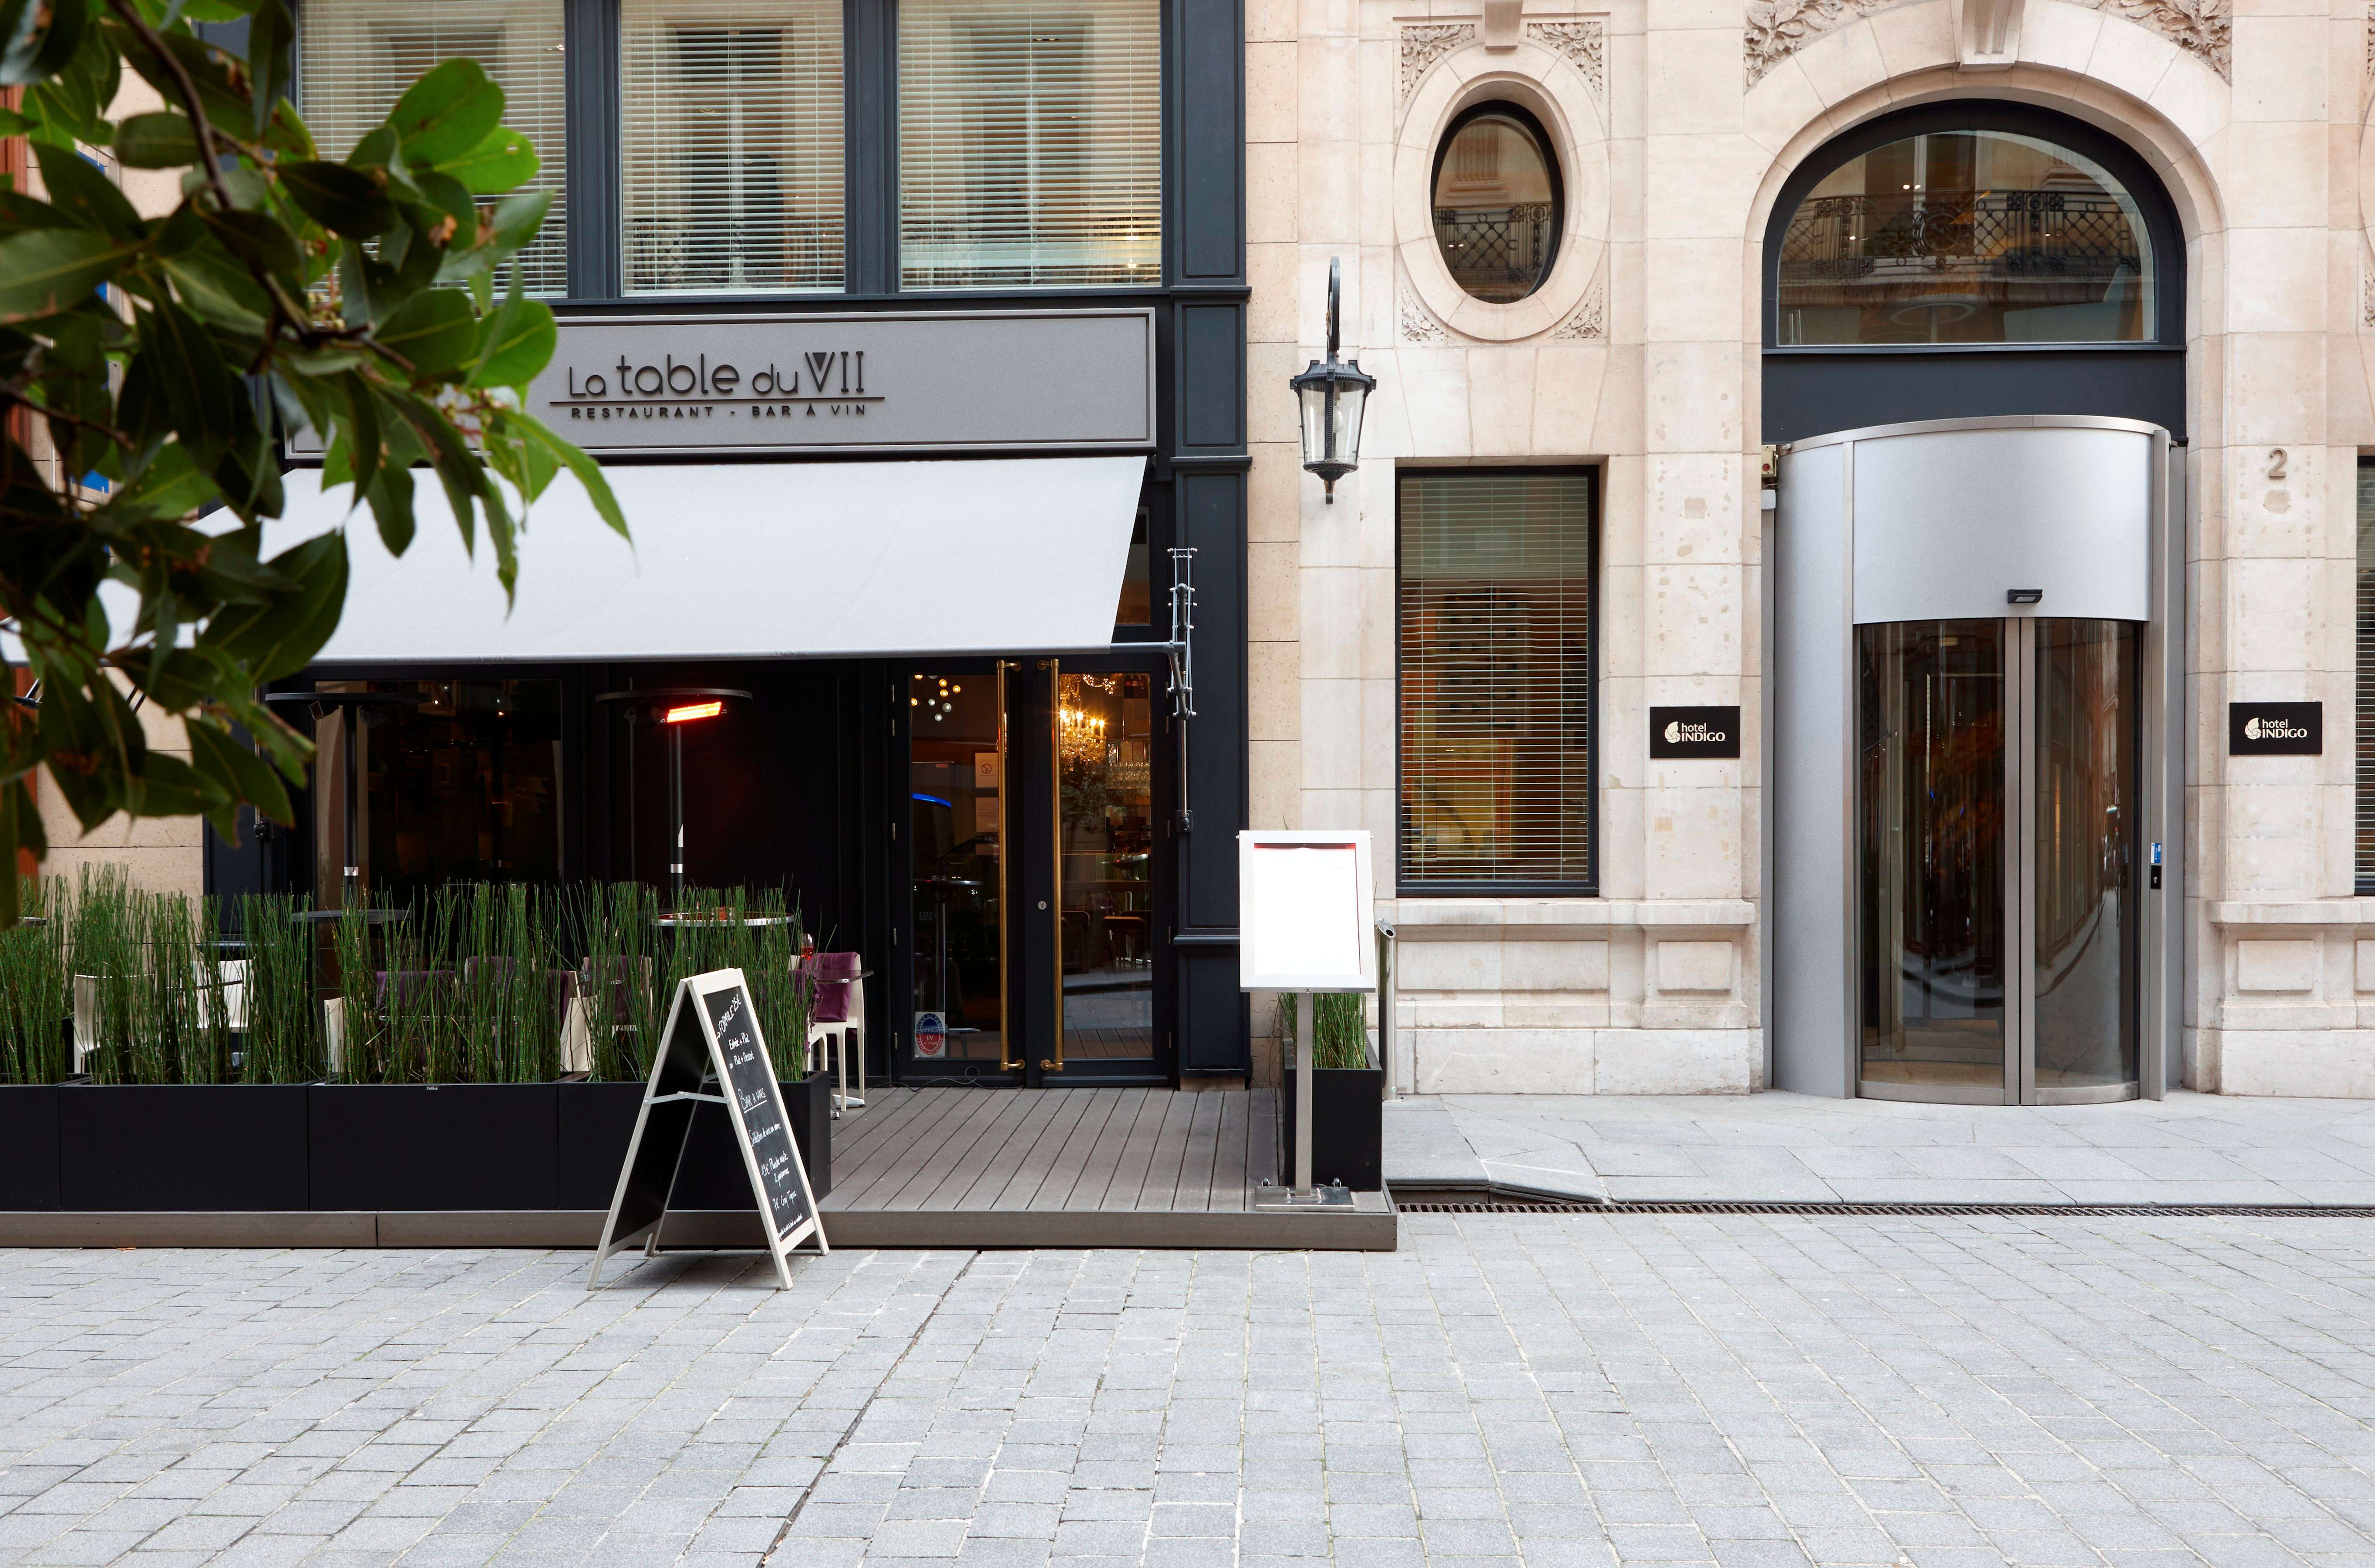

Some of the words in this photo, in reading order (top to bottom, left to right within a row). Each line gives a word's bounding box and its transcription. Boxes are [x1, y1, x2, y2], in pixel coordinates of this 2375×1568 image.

[569, 367, 606, 397] La
[616, 353, 740, 395] table
[752, 363, 798, 394] du
[804, 351, 864, 393] VII
[572, 406, 714, 418] RESTAURANT
[752, 405, 791, 416] BAR
[805, 403, 816, 416] À
[831, 404, 865, 416] VIN
[2268, 448, 2287, 478] 2
[1681, 723, 1707, 732] hotel
[2262, 719, 2287, 728] hotel
[1681, 732, 1726, 742] INDIGO
[2262, 728, 2307, 738] INDIGO
[741, 1032, 751, 1044] Plat
